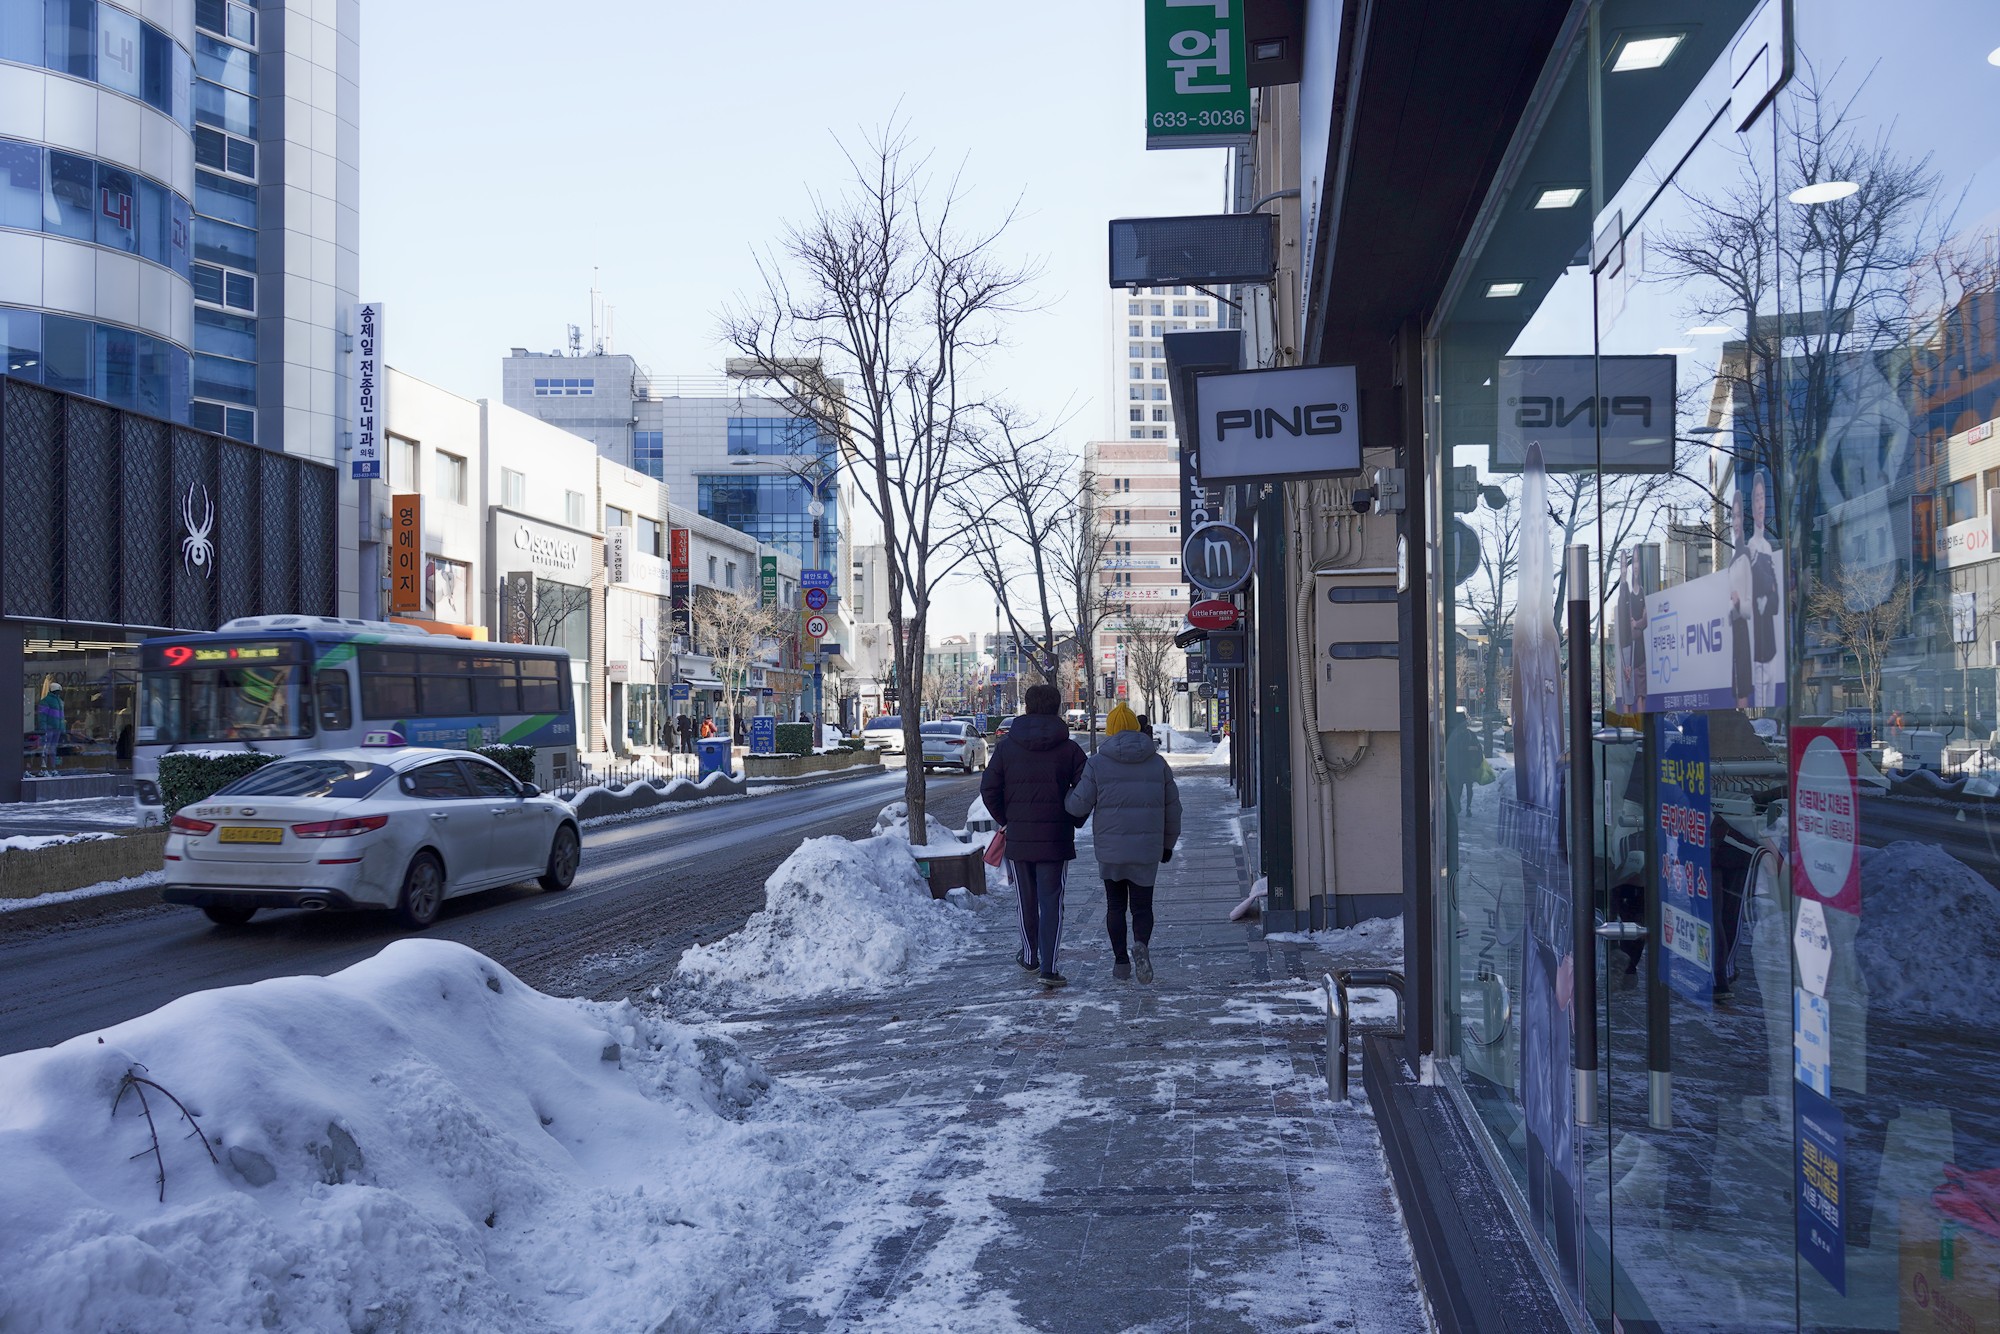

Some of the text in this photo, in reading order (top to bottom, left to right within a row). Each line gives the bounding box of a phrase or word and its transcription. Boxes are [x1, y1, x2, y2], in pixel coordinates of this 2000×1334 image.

[1153, 110, 1245, 128] 633-3036
[360, 305, 375, 356] 송제일
[1216, 403, 1342, 442] PING
[360, 448, 375, 458] 의원
[400, 508, 414, 593] 영에이지
[811, 622, 823, 633] 30
[1686, 618, 1722, 656] PING
[164, 646, 193, 666] 9
[754, 719, 773, 730] 주차
[1661, 759, 1705, 795] 코로나 상생
[1661, 803, 1706, 848] 국민지원금
